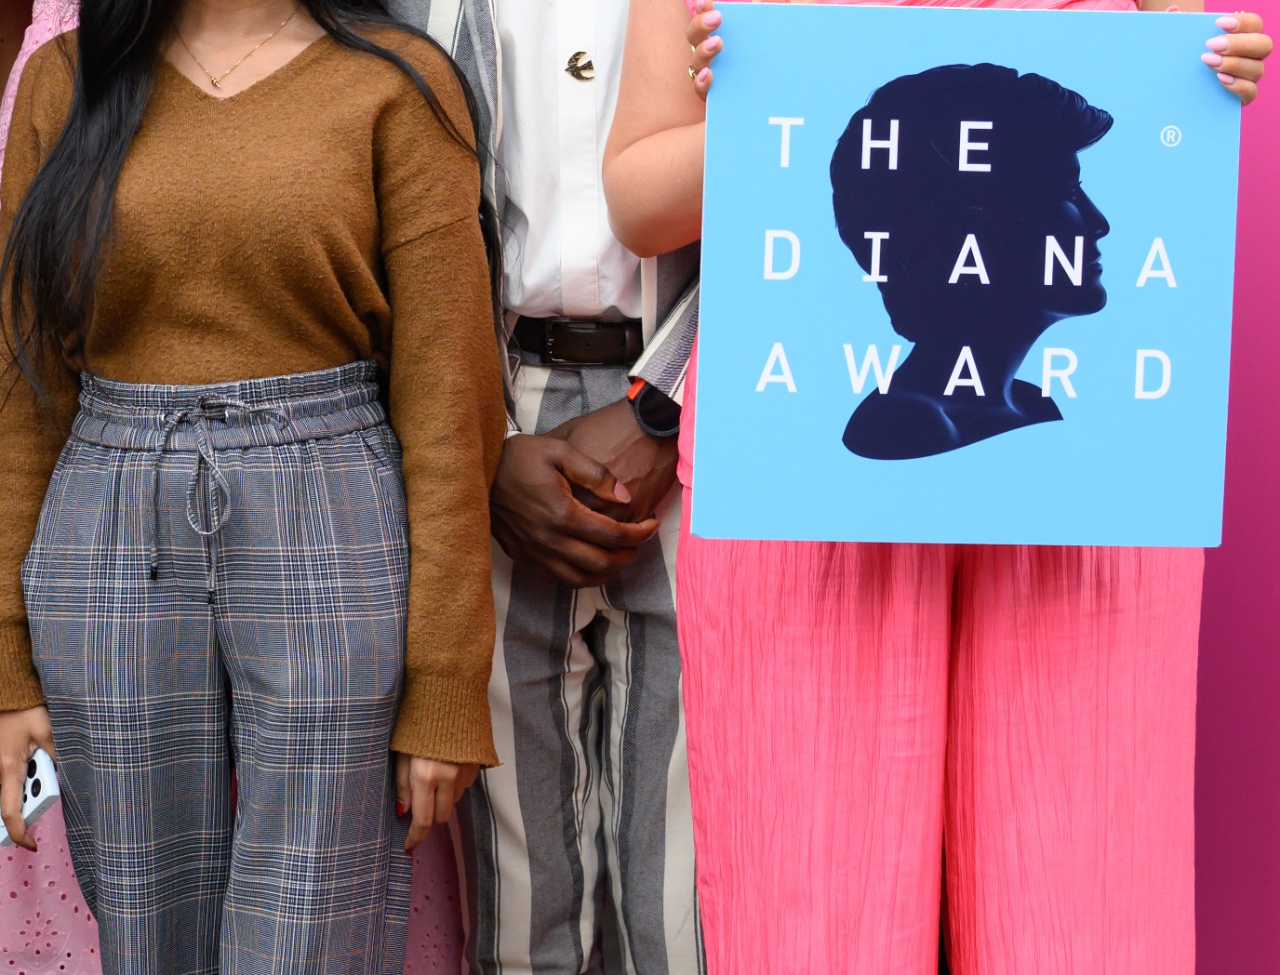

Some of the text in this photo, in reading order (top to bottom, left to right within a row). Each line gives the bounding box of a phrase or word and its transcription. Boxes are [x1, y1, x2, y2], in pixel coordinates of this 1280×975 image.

[768, 116, 994, 172] THE
[763, 229, 1177, 288] DIANA
[755, 342, 1172, 400] AWARD
